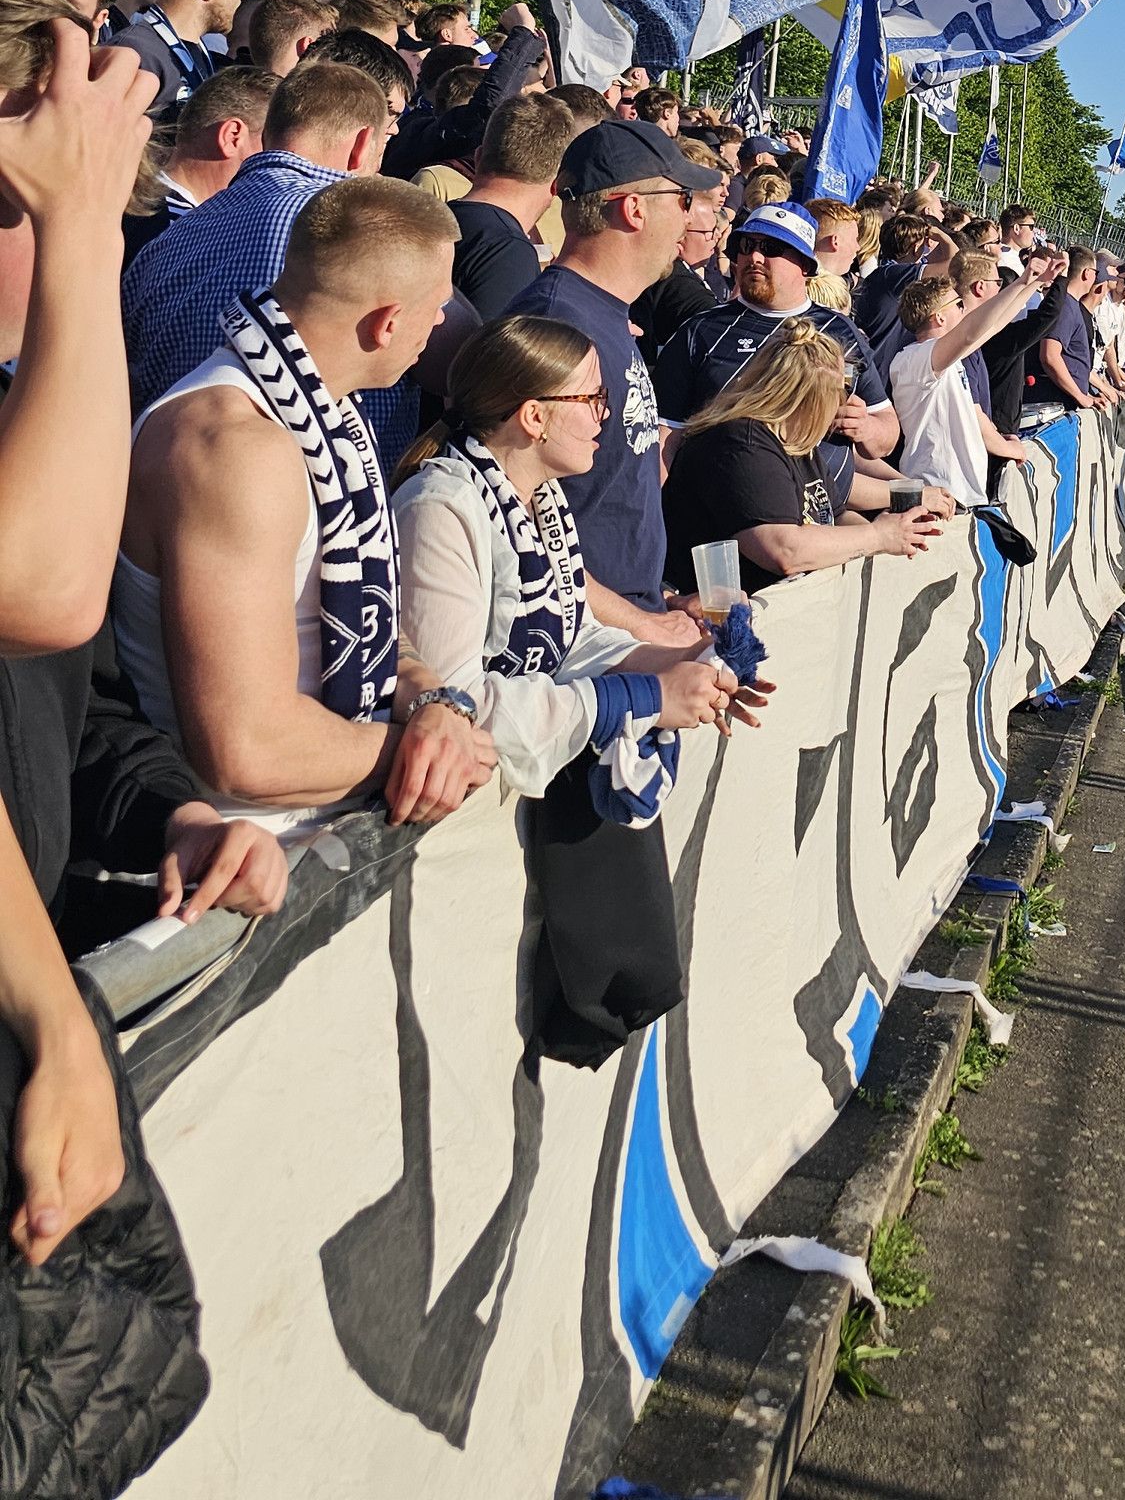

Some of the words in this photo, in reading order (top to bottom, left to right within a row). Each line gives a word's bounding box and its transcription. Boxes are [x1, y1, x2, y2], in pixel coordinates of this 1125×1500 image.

[541, 505, 565, 553] Geist
[559, 558, 574, 597] dem
[563, 607, 576, 632] Mit
